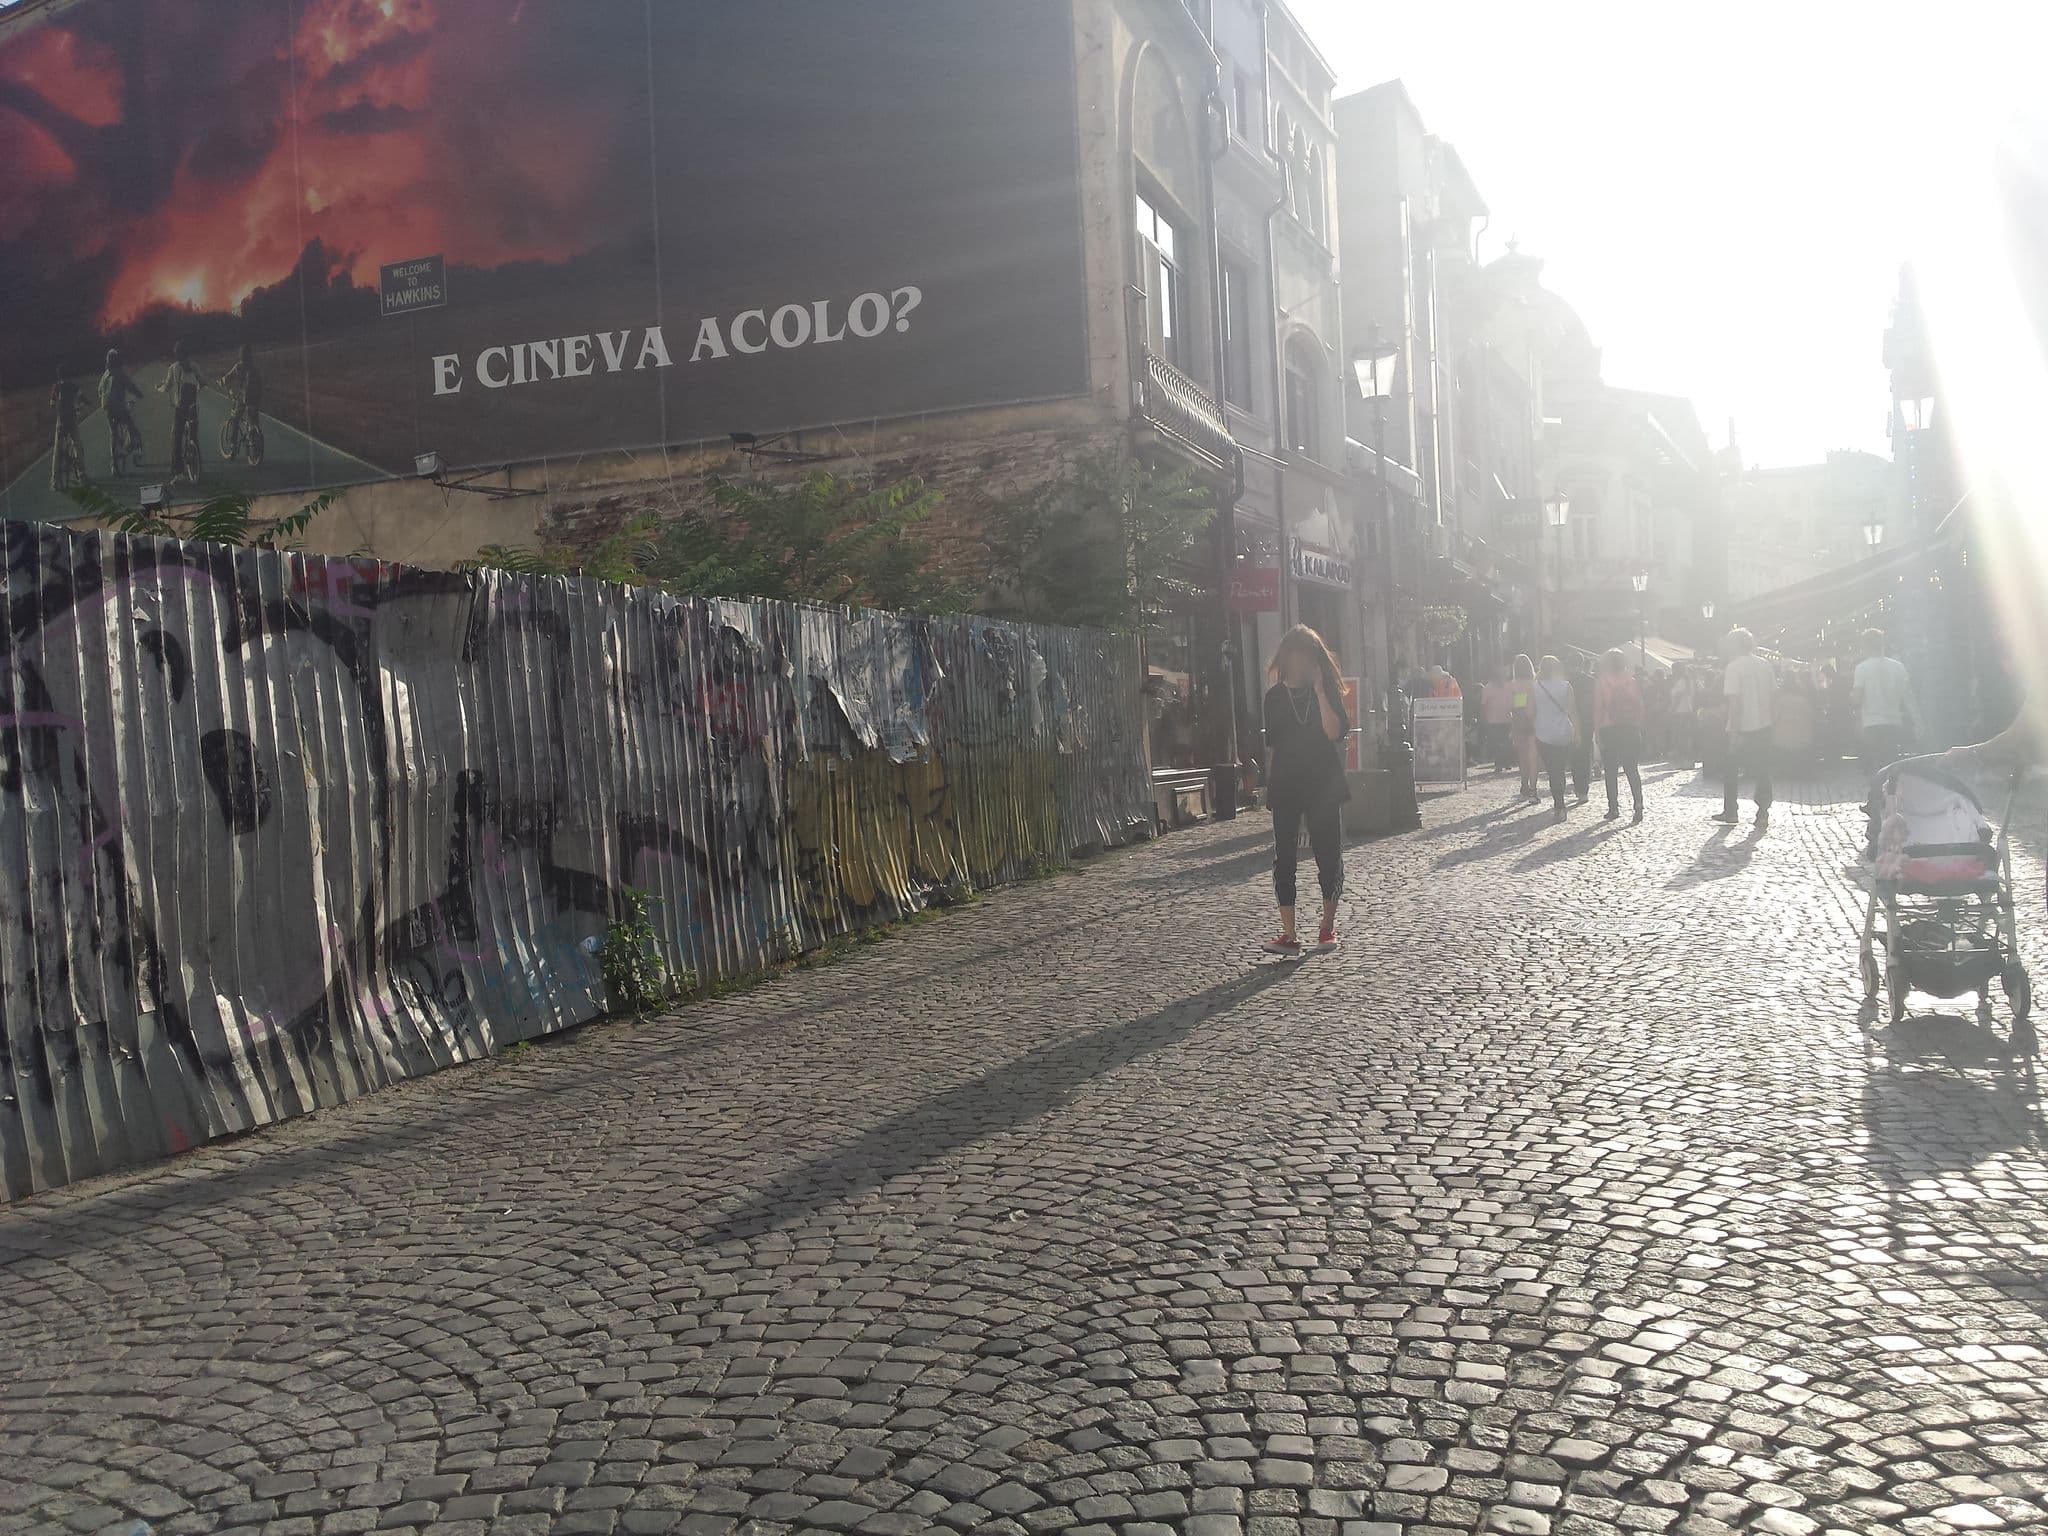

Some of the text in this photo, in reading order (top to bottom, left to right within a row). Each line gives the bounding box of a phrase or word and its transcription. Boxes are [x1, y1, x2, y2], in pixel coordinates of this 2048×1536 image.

[393, 262, 432, 279] WELCOME
[408, 276, 418, 287] TO
[386, 285, 441, 309] HAWKINS
[432, 285, 923, 396] E CINEVA ACOLO?
